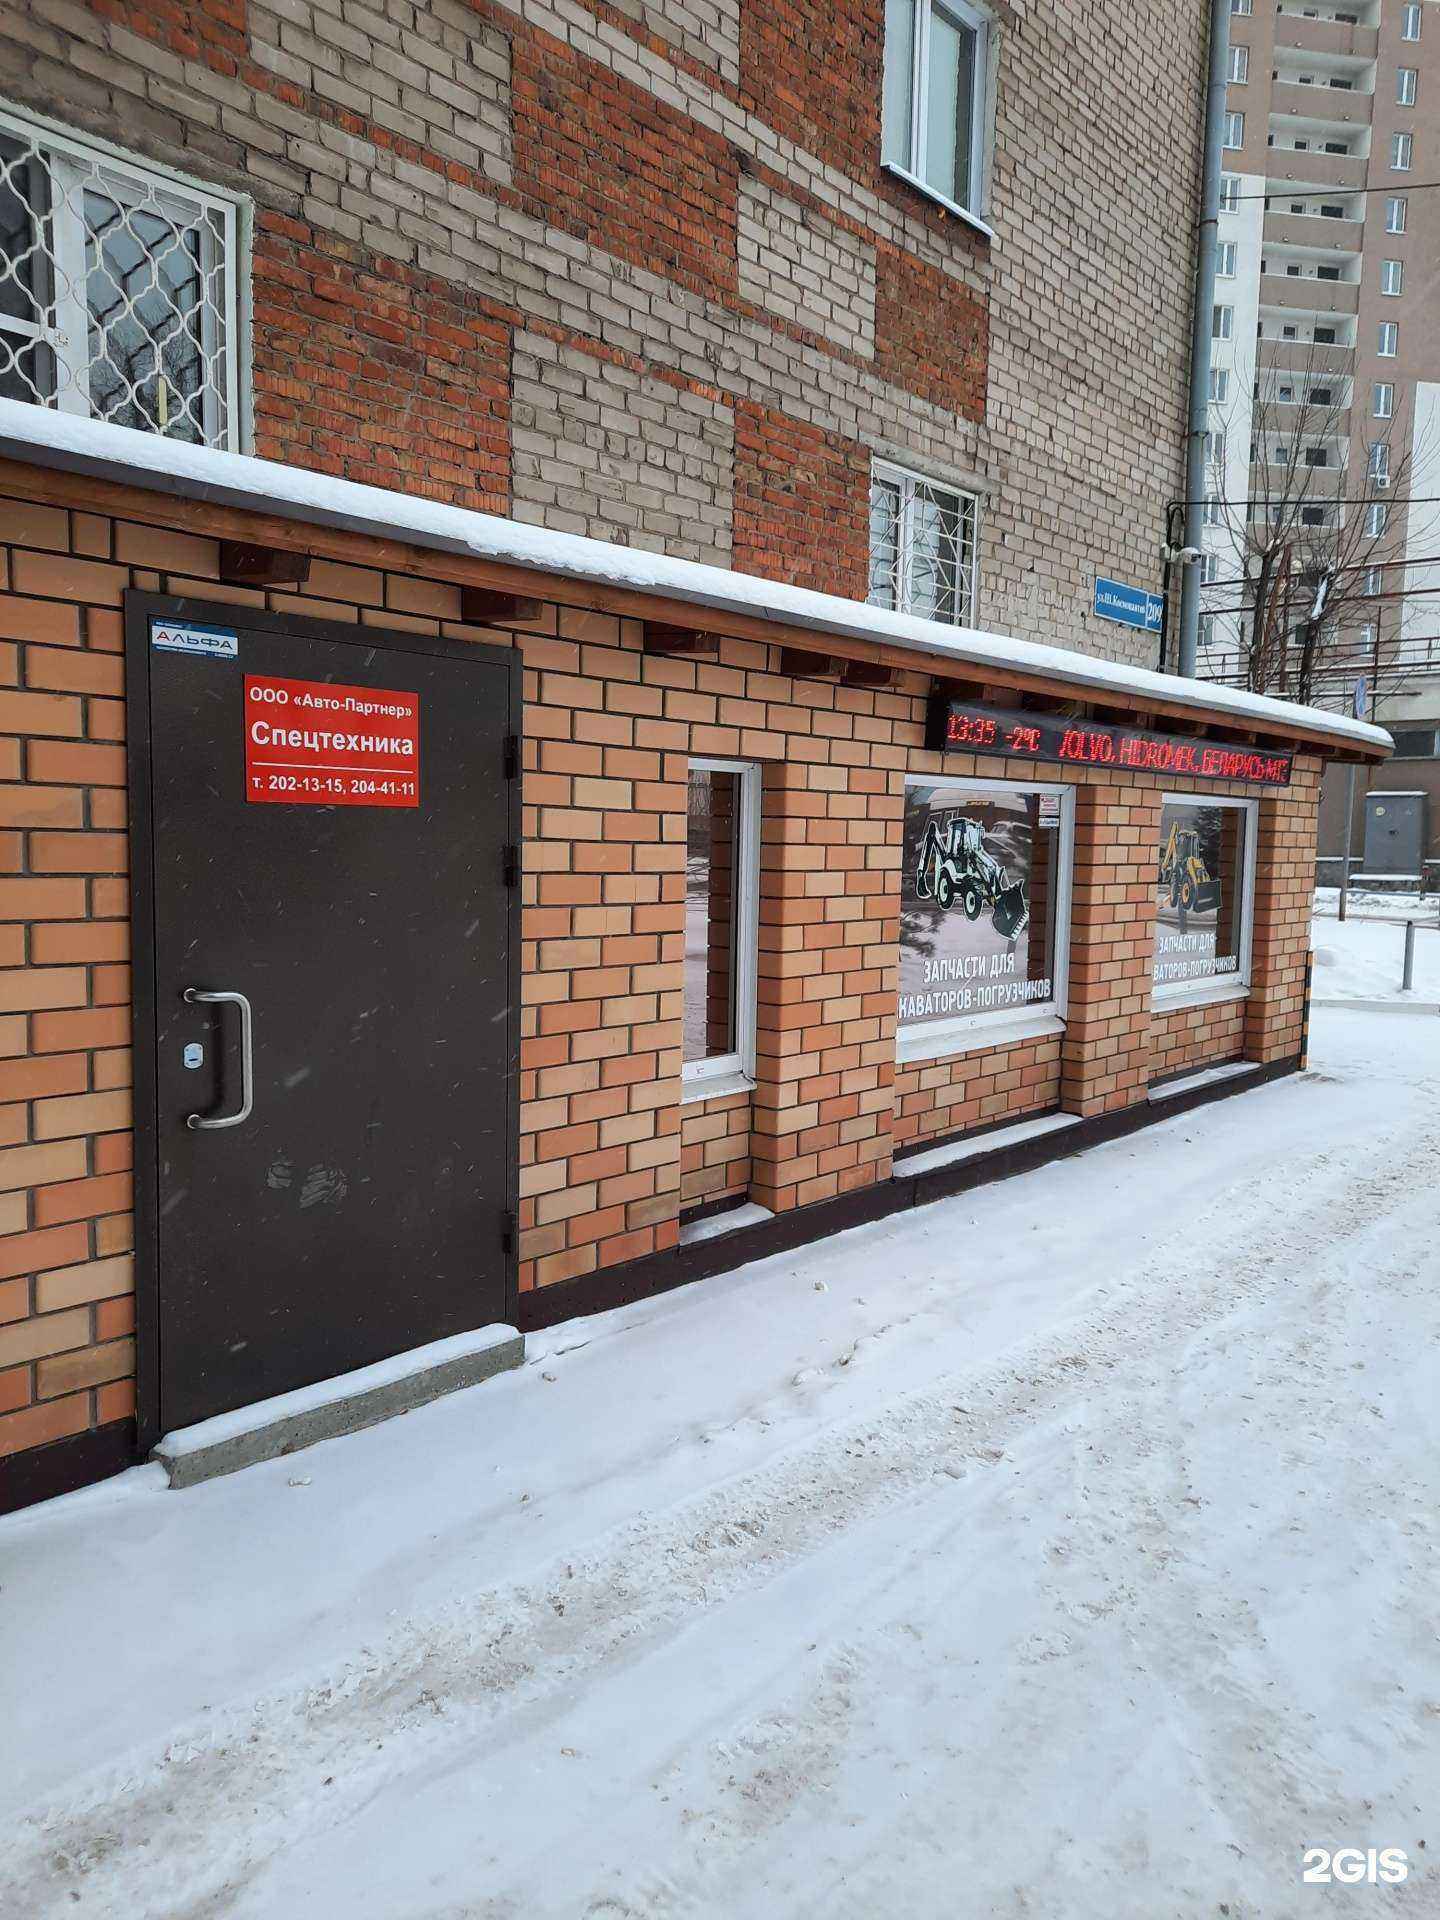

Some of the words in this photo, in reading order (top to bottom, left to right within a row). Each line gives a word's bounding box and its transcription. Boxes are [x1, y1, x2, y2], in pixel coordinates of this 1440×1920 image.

[1147, 603, 1162, 623] 209
[156, 631, 233, 649] АЛЬФА
[250, 687, 288, 705] ООО
[293, 693, 413, 718] «Авто-Партнер»
[251, 721, 414, 755] Спецтехника
[252, 777, 264, 789] т.
[268, 775, 347, 795] 202-13-15,
[350, 780, 416, 796] 204-41-11
[1158, 934, 1198, 954] ЗАПЧАСТИ
[1199, 931, 1215, 953] ДЛЯ
[923, 956, 986, 983] ЗАПЧАСТИ
[989, 952, 1015, 978] ДЛЯ
